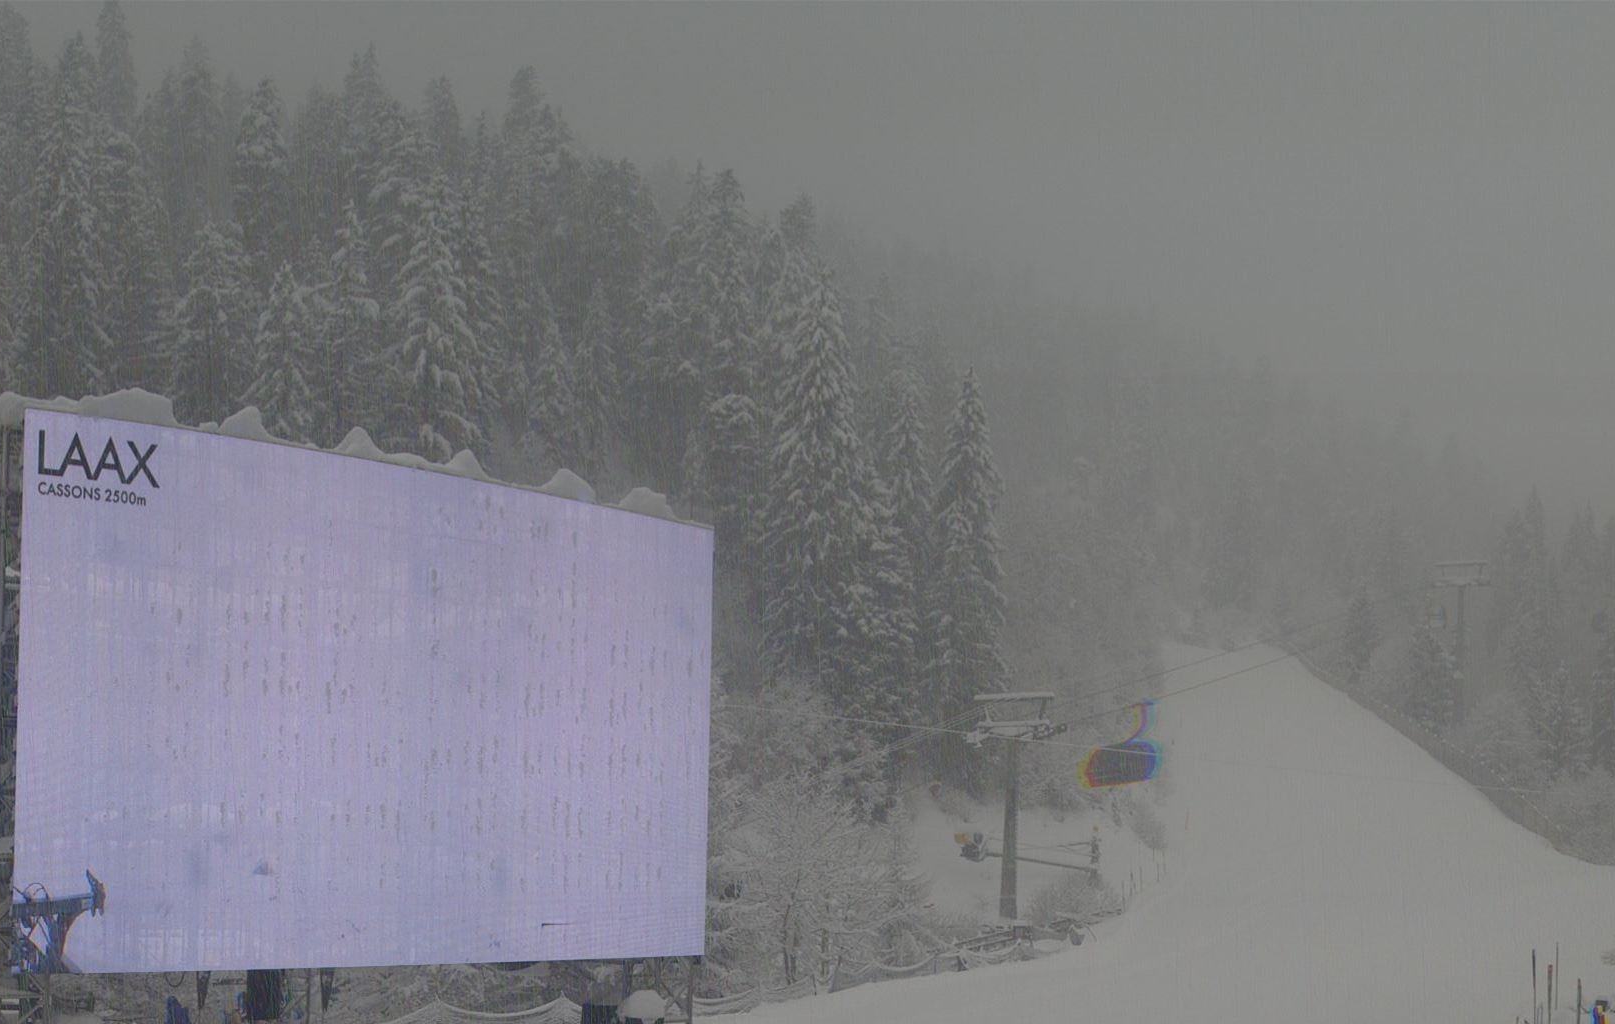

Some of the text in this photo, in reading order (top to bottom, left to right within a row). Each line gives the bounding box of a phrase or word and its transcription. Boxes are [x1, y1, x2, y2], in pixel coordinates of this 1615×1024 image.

[38, 429, 160, 488] LAAX
[38, 481, 147, 506] CASSONS 2500m
